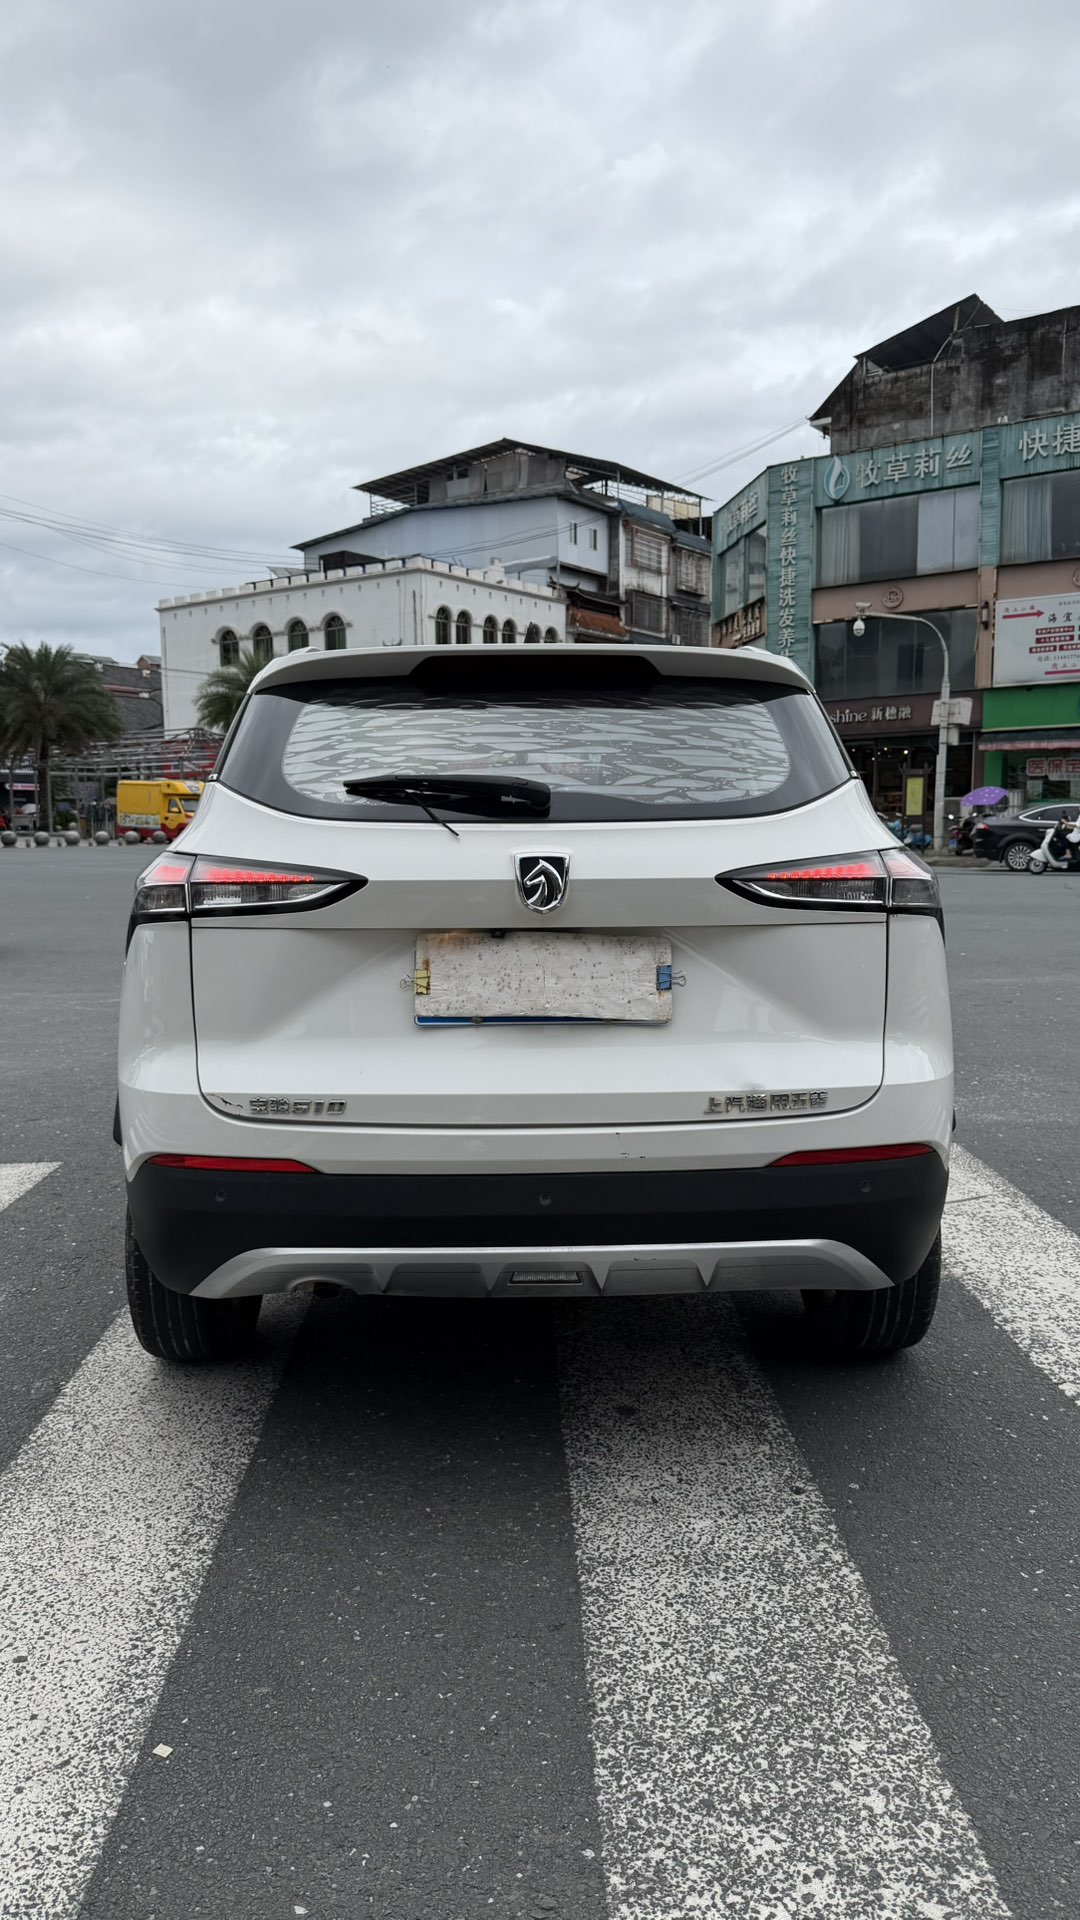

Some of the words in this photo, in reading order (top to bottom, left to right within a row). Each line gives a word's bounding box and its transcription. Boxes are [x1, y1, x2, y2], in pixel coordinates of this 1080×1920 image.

[1018, 422, 1080, 461] 快捷
[856, 444, 973, 489] 牧草莉丝
[703, 1089, 828, 1115] 上汽通用五菱
